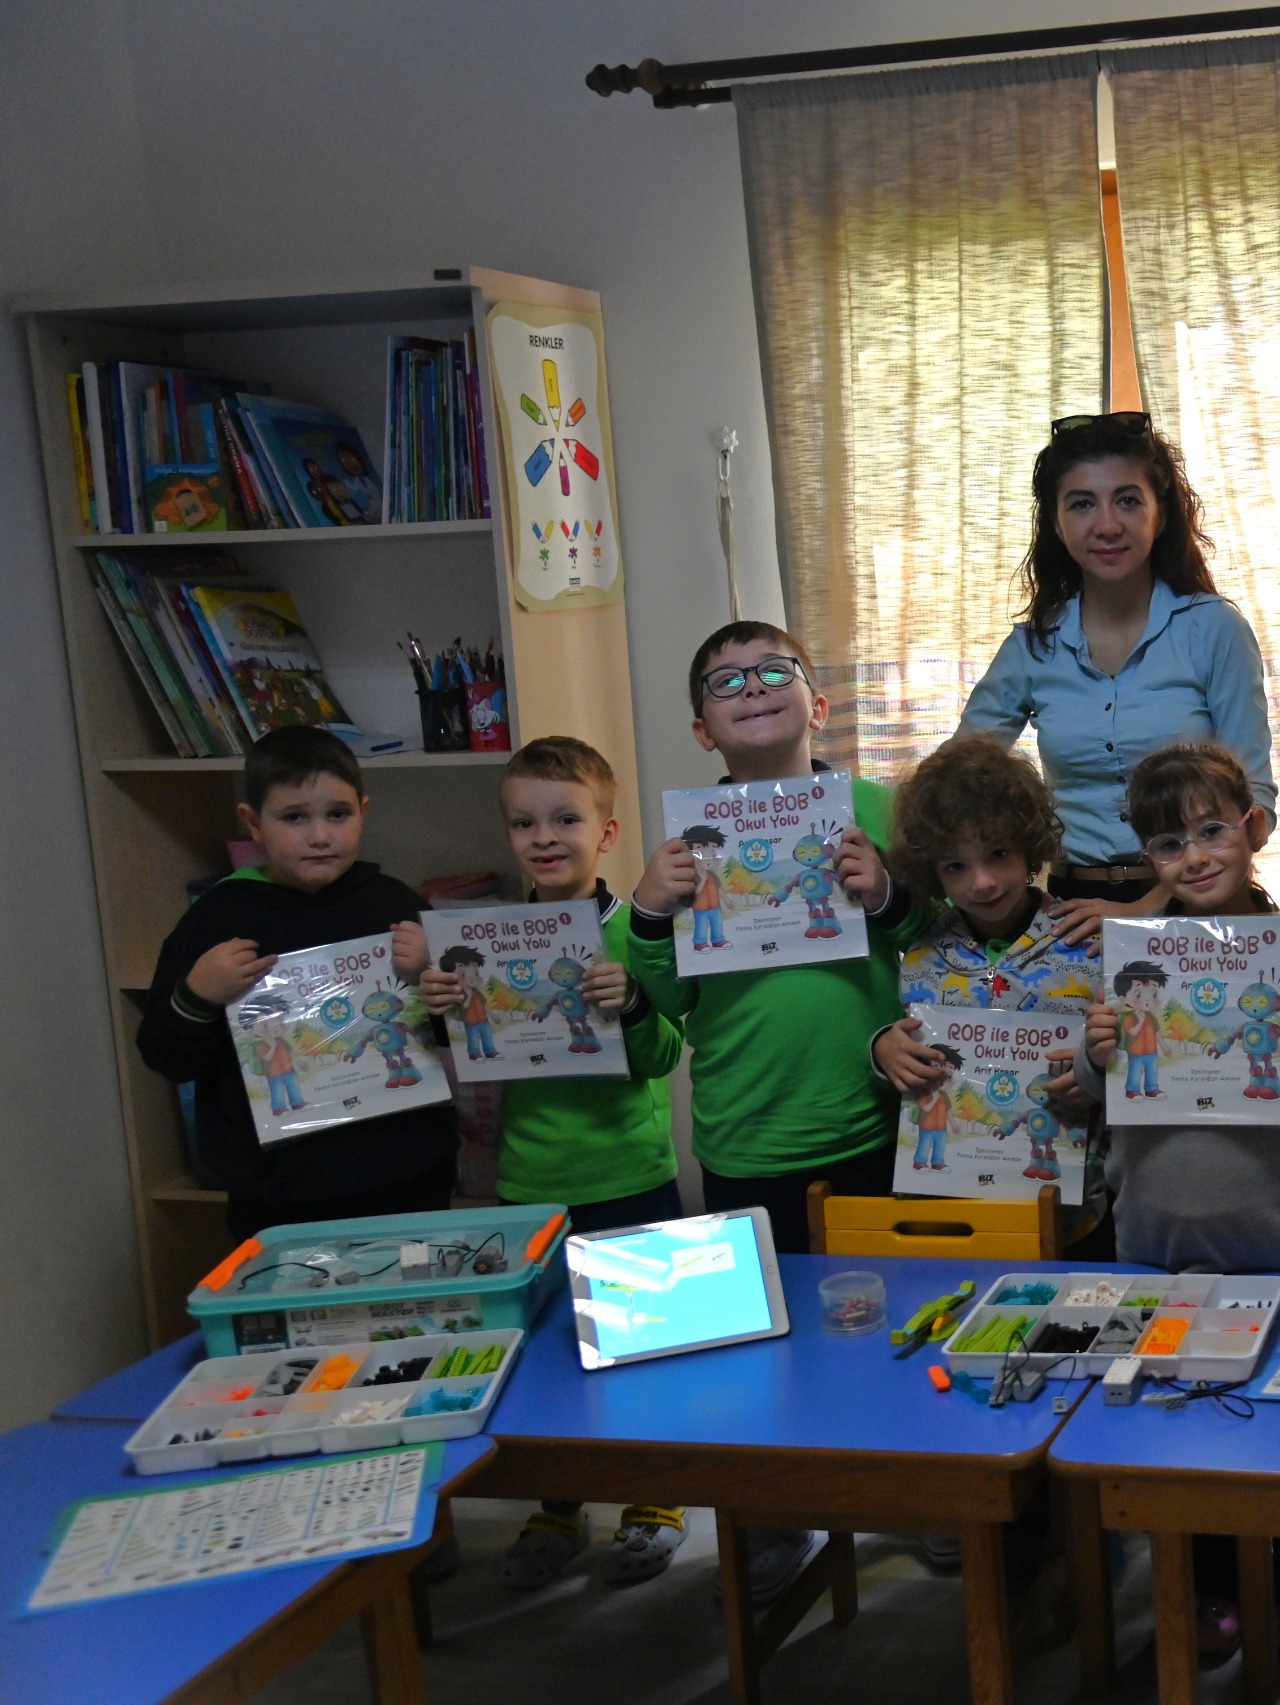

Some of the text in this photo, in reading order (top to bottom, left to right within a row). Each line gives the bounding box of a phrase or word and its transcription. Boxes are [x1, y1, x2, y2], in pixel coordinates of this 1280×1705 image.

[529, 335, 564, 350] RENKLER
[704, 800, 743, 820] ROB
[749, 800, 768, 814] ile
[773, 793, 809, 813] BOB
[734, 814, 799, 833] Okul Yolu
[461, 922, 497, 941] ROB
[502, 922, 520, 936] ile
[523, 918, 558, 936] BOB
[491, 938, 551, 953] Okul Yolu
[1147, 936, 1189, 956] ROB
[1194, 937, 1215, 952] ile
[1221, 935, 1260, 955] BOB
[308, 963, 330, 979] ile
[333, 953, 371, 975] BOB
[1179, 957, 1248, 972] Okul Yolu
[948, 1023, 986, 1042] ROB
[991, 1028, 1009, 1042] ile
[1015, 1028, 1052, 1047] BOB
[975, 1044, 1039, 1061] Okul Yolu
